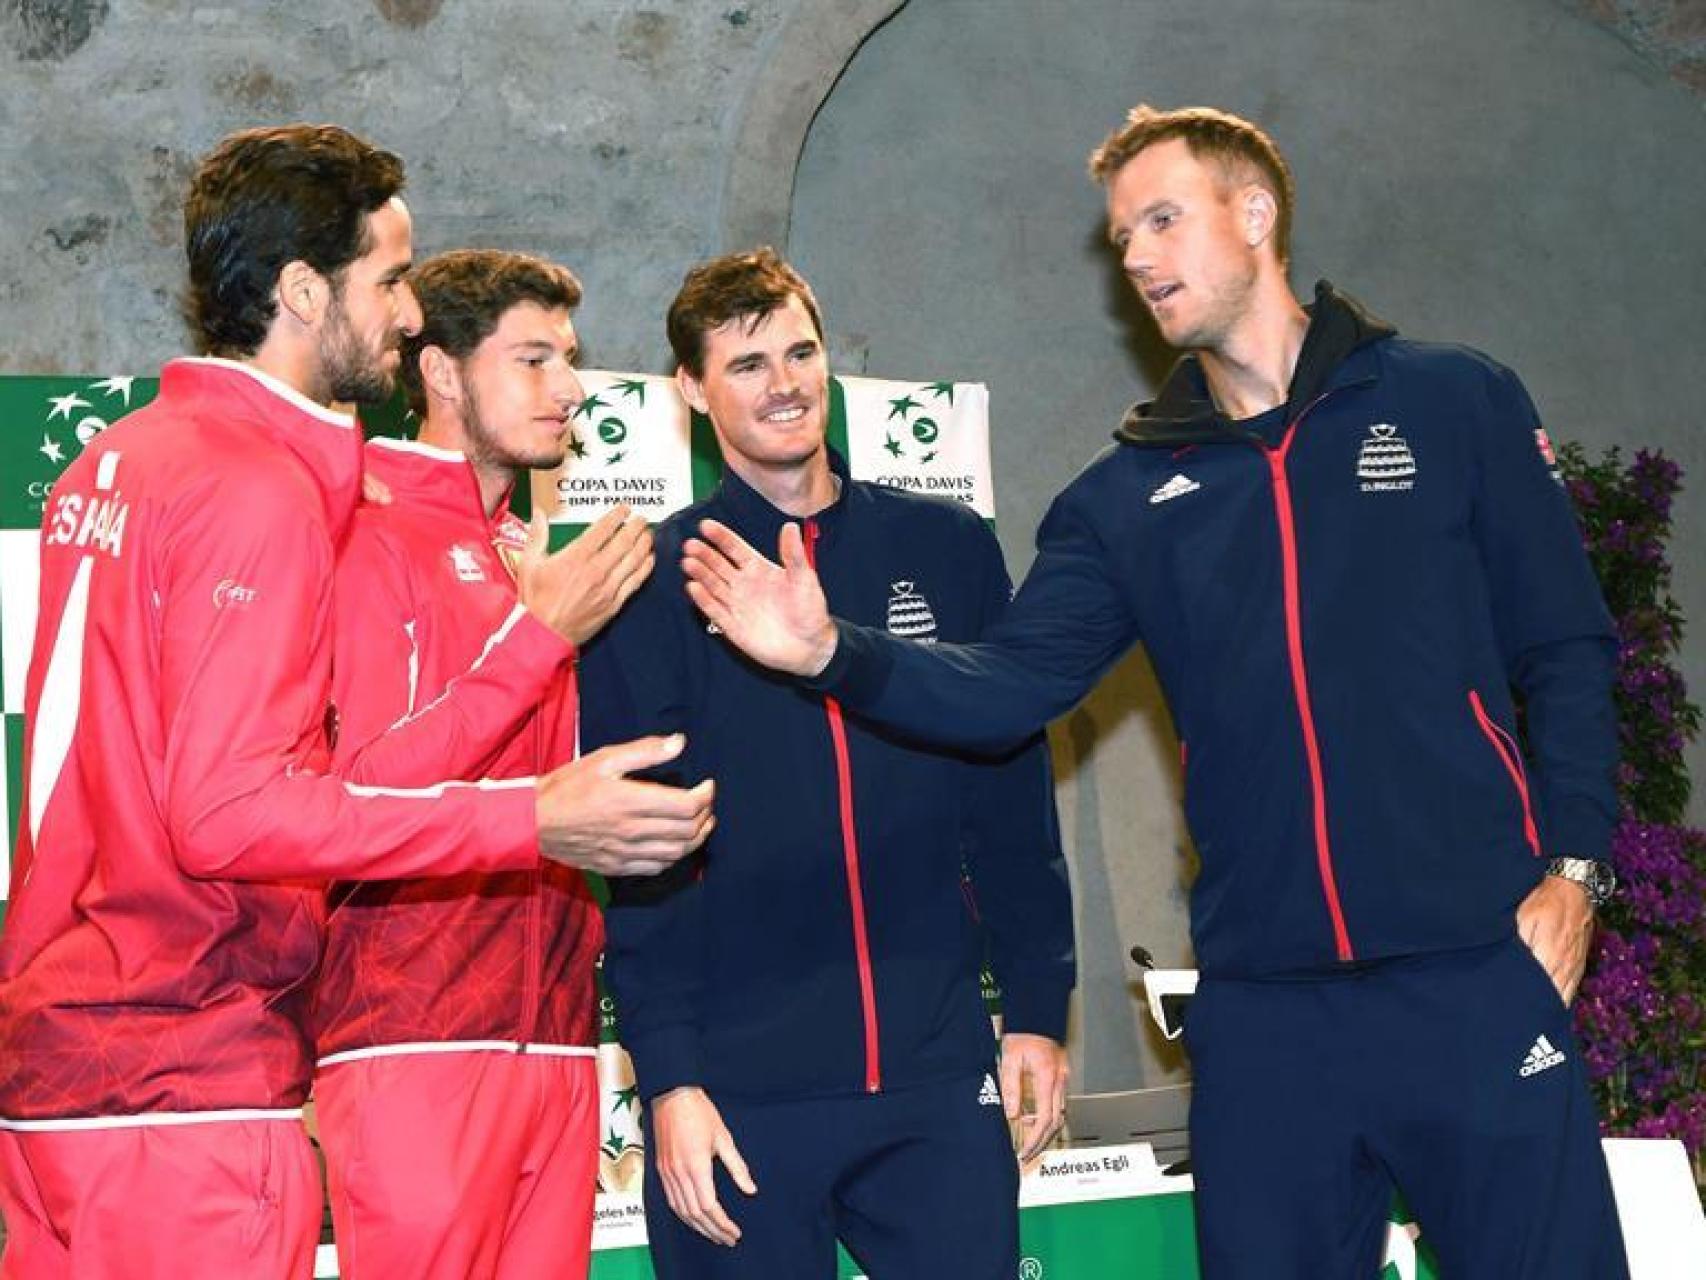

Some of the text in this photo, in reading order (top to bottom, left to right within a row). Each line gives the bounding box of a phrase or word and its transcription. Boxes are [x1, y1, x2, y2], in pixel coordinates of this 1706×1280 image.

[557, 478, 666, 491] COPA DAVIS
[926, 475, 975, 489] DAVIS
[1040, 1155, 1130, 1177] Andreas Egli
